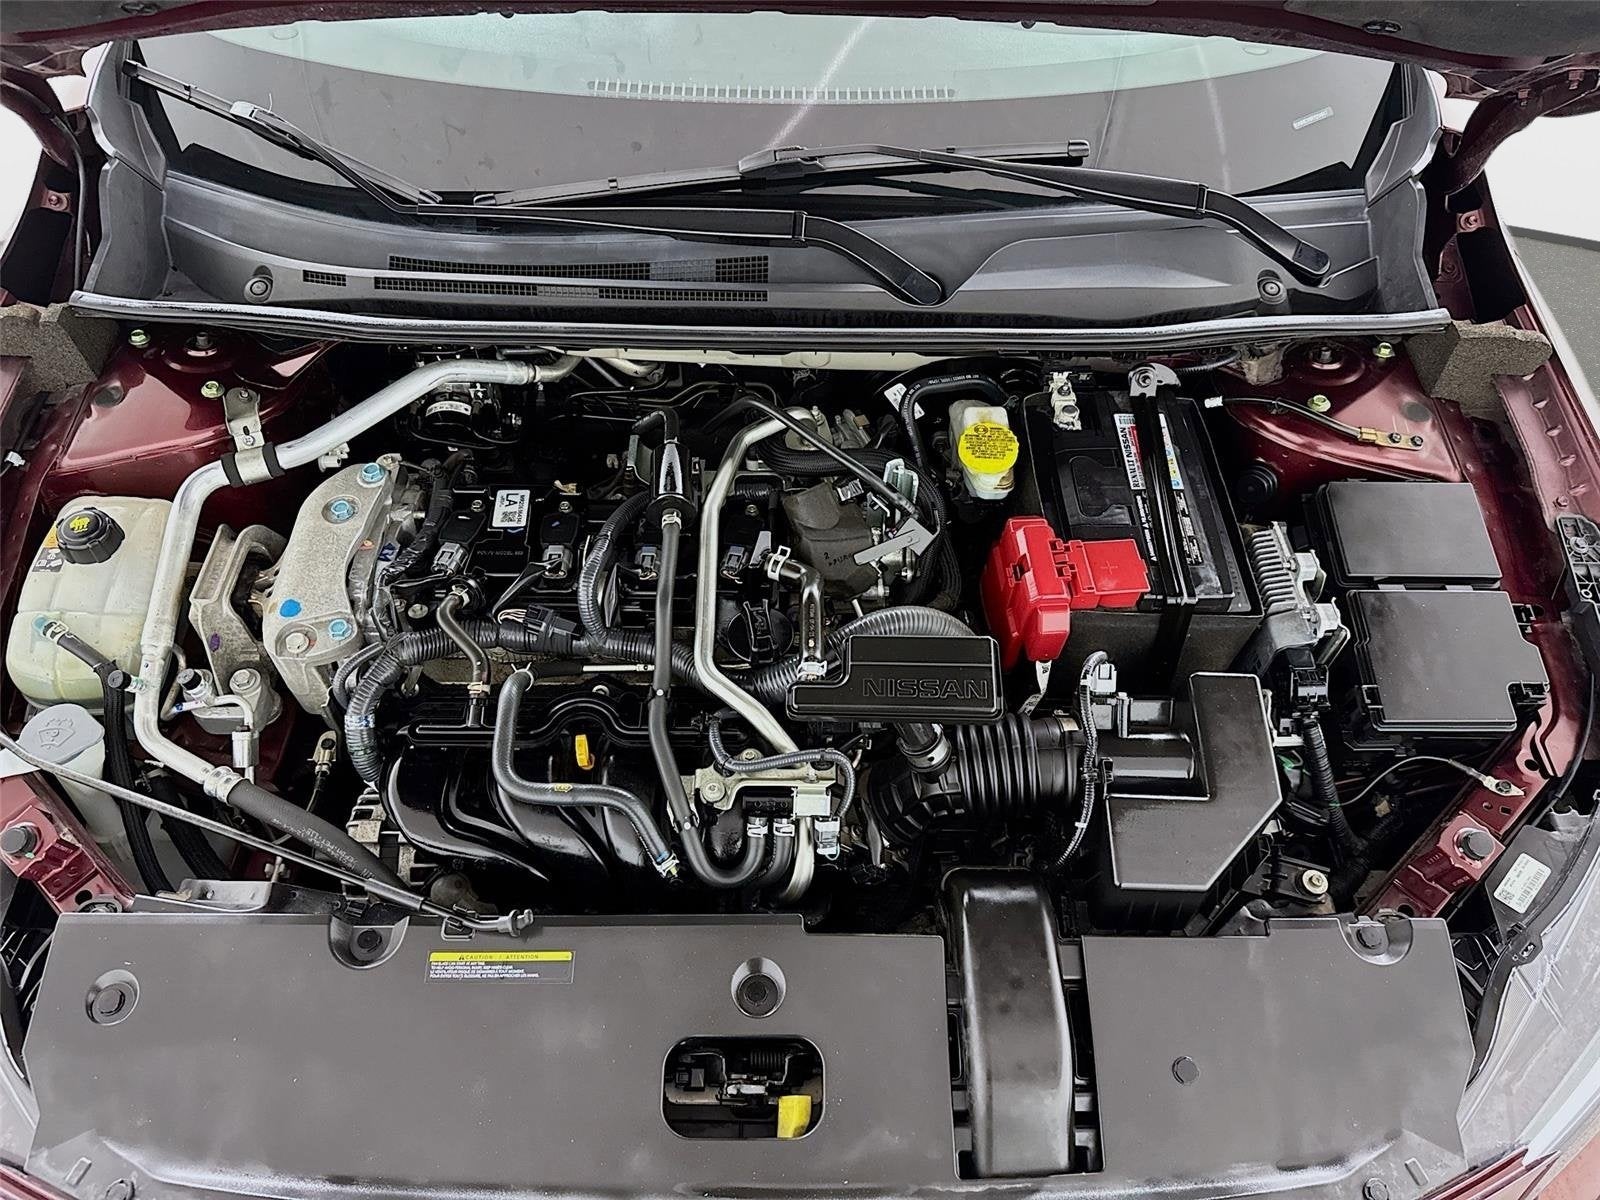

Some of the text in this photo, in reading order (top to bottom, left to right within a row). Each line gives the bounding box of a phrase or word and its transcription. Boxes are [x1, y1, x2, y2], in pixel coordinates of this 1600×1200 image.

[1119, 426, 1132, 458] NISSAN
[505, 493, 518, 507] LA
[862, 678, 988, 699] NISSAN
